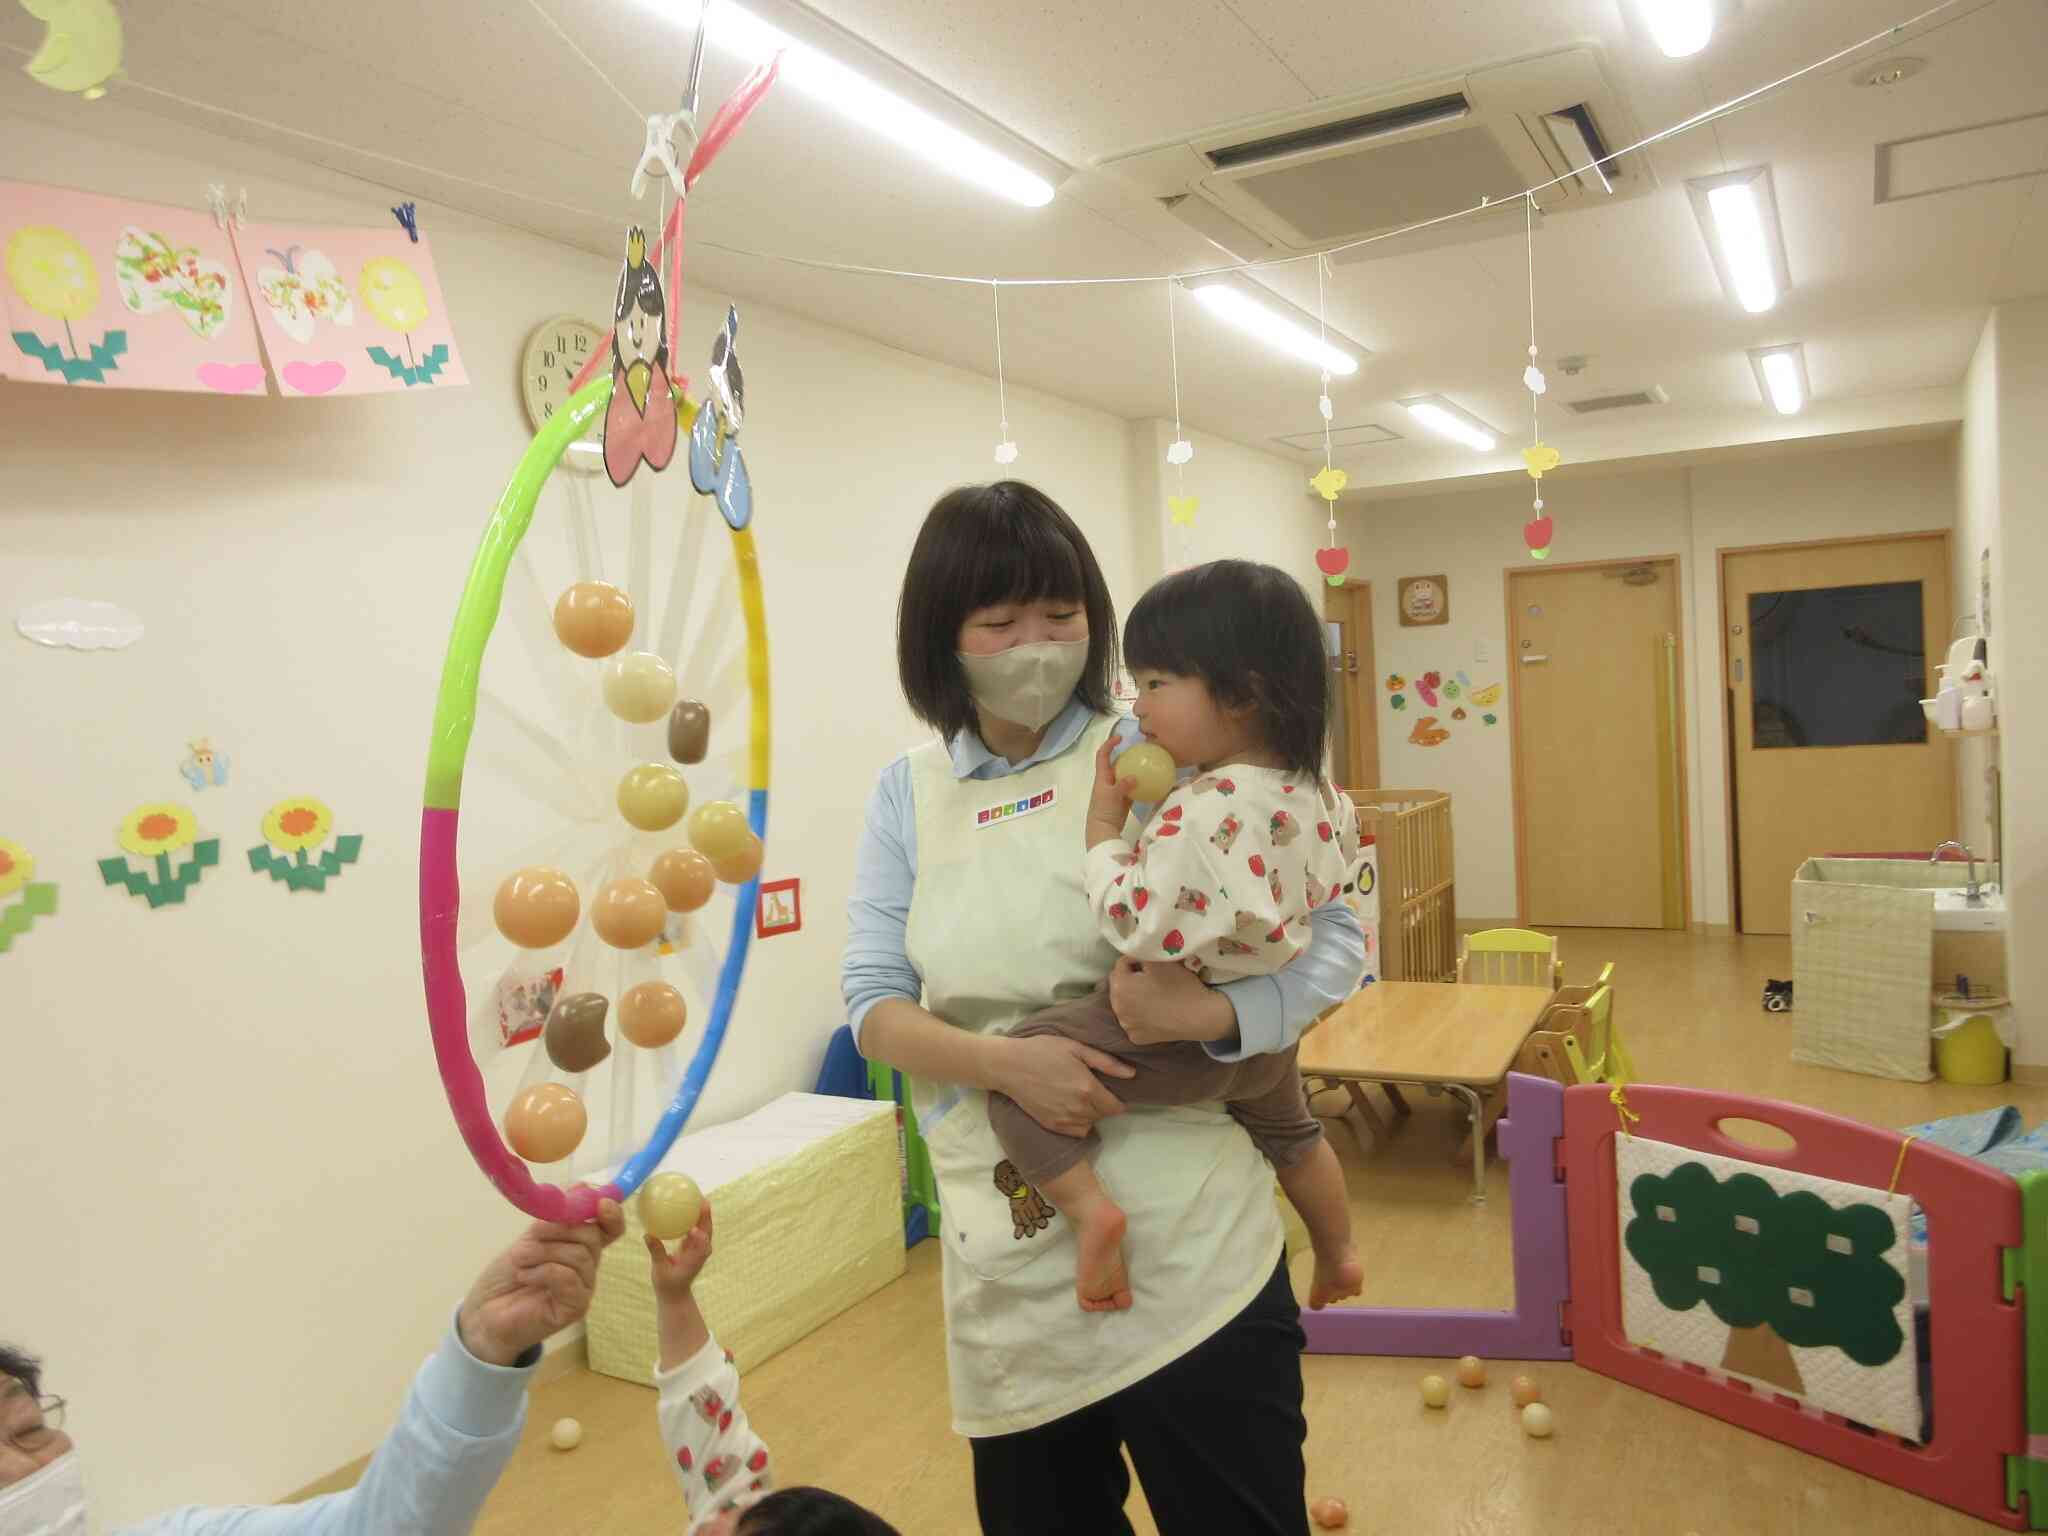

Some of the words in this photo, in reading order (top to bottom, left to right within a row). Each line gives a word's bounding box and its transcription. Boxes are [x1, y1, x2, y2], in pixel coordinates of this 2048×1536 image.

[556, 335, 566, 354] 11
[575, 334, 587, 352] 12
[544, 351, 555, 368] 10
[539, 376, 547, 392] 9
[544, 402, 553, 418] 8
